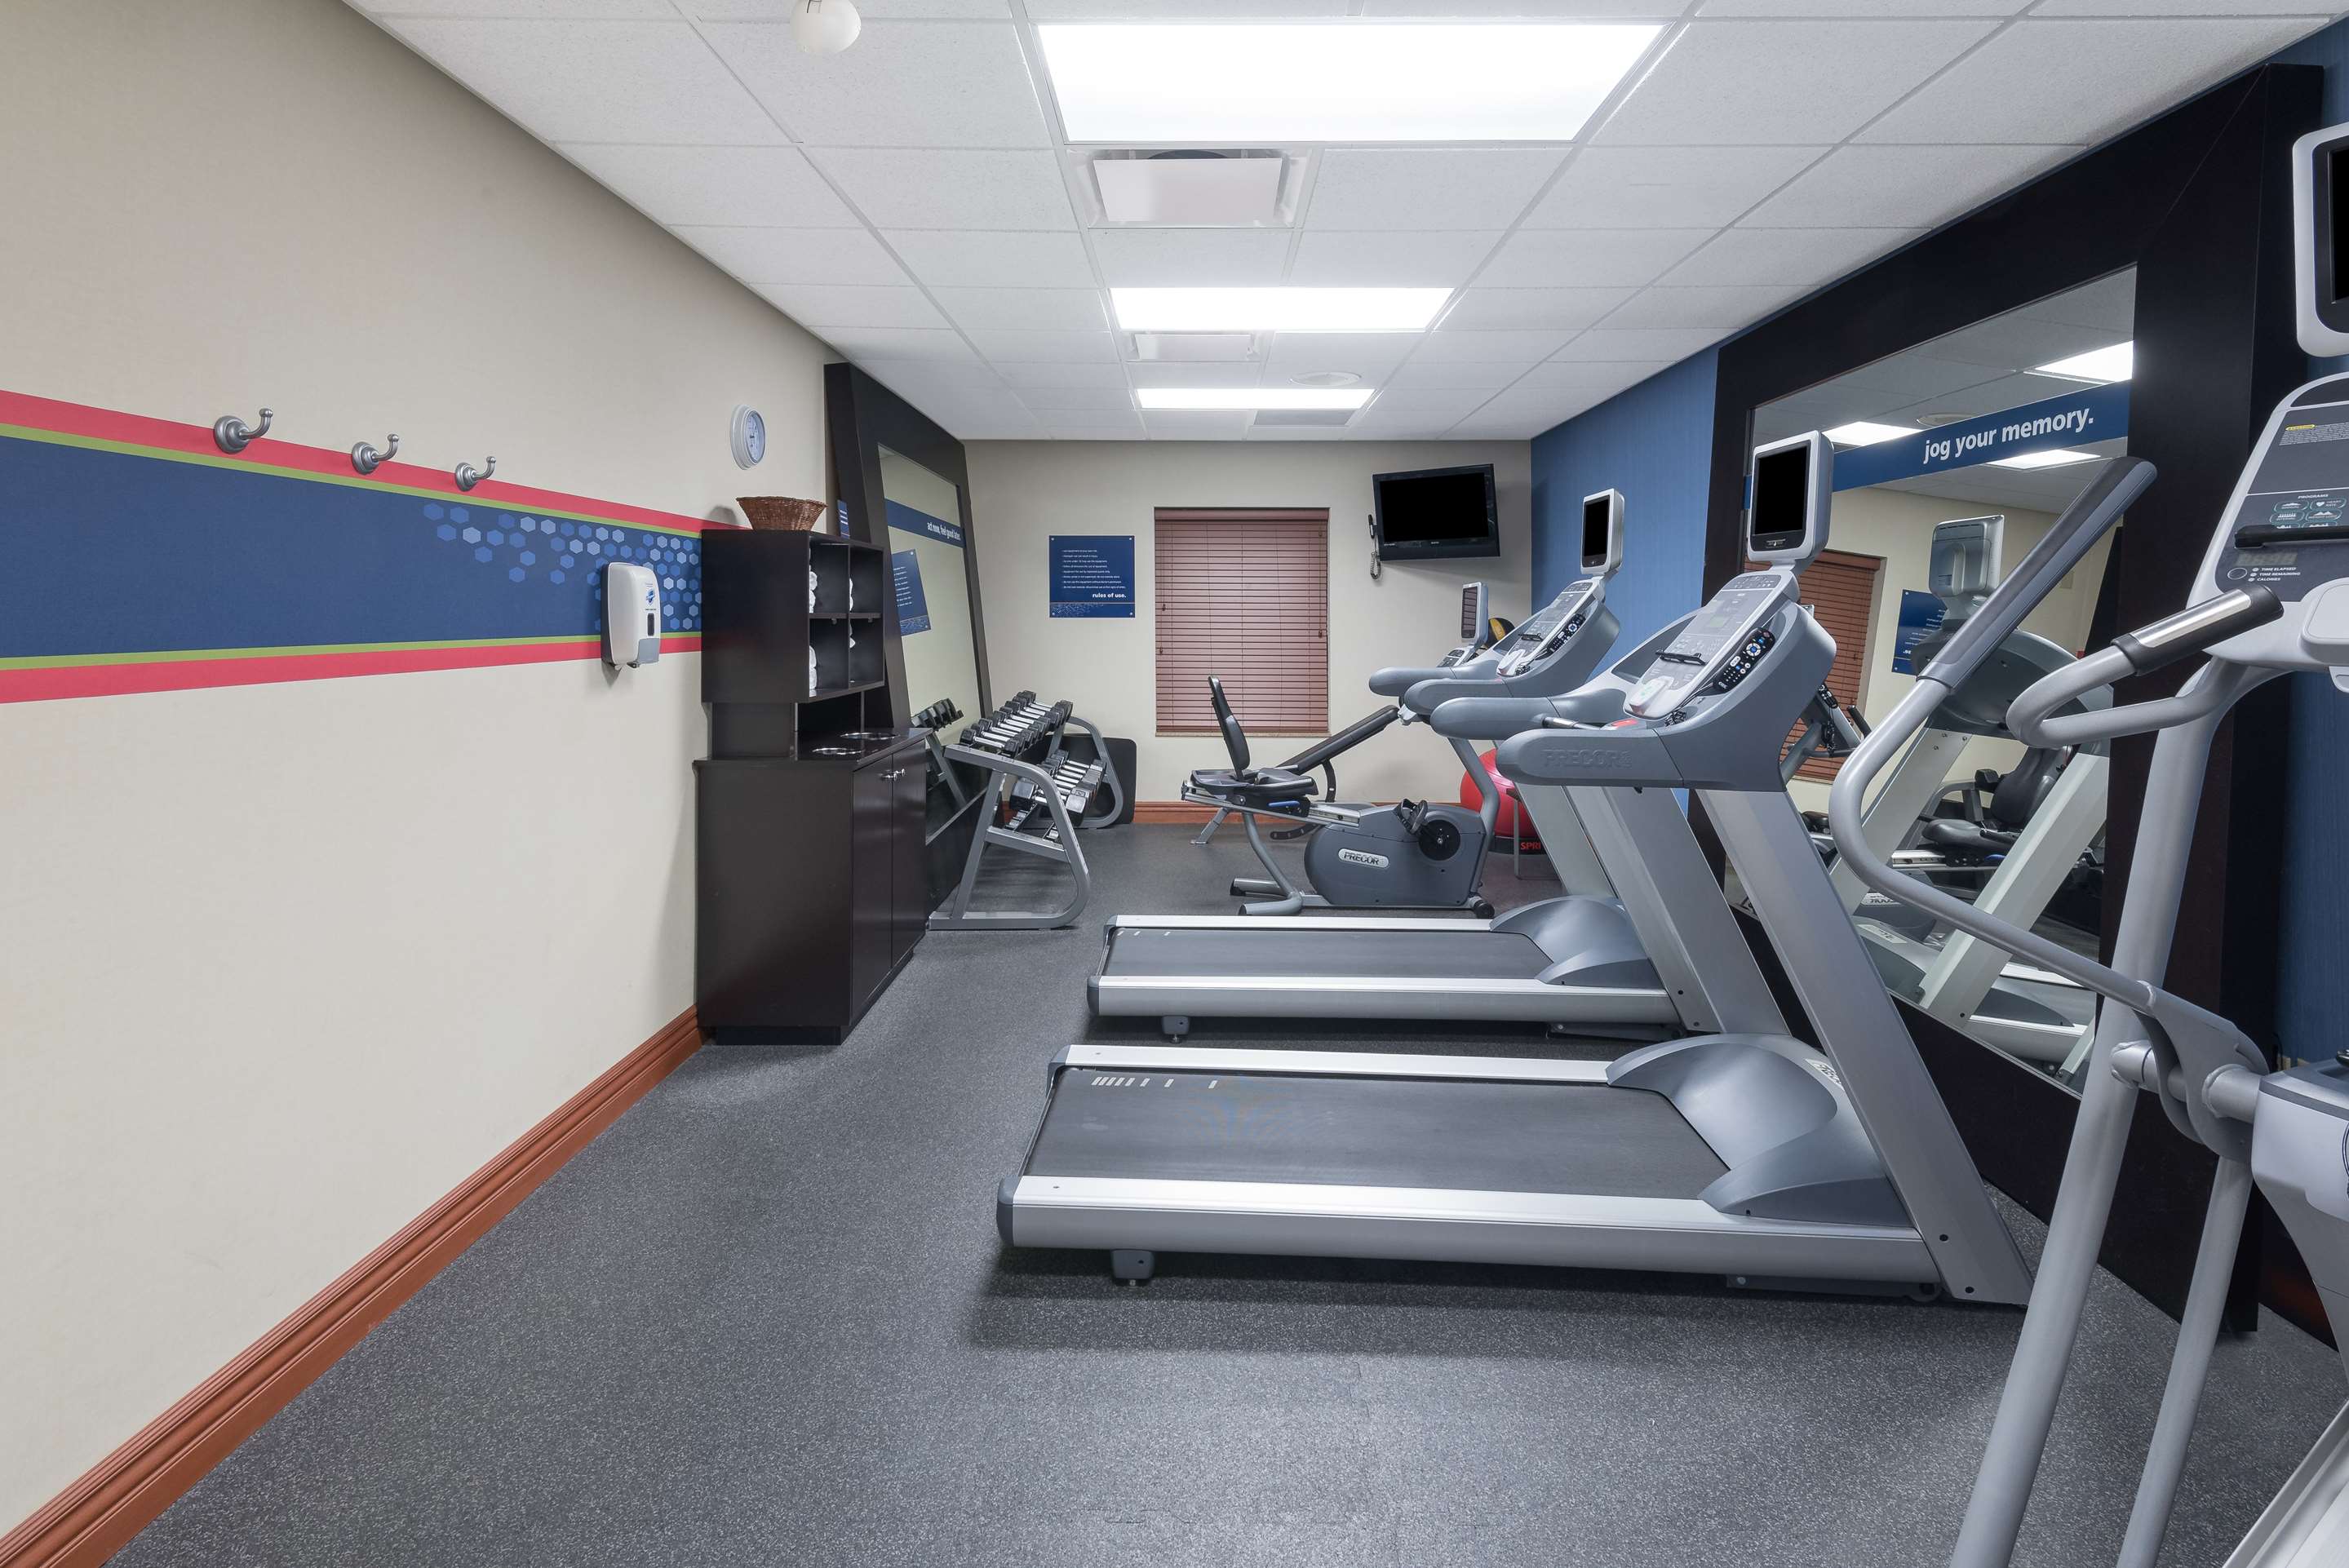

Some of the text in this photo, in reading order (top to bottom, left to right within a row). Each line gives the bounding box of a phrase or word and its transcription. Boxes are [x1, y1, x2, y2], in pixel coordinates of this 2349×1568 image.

[1923, 408, 2094, 464] jog your memory.
[1344, 852, 1379, 866] PRECOR
